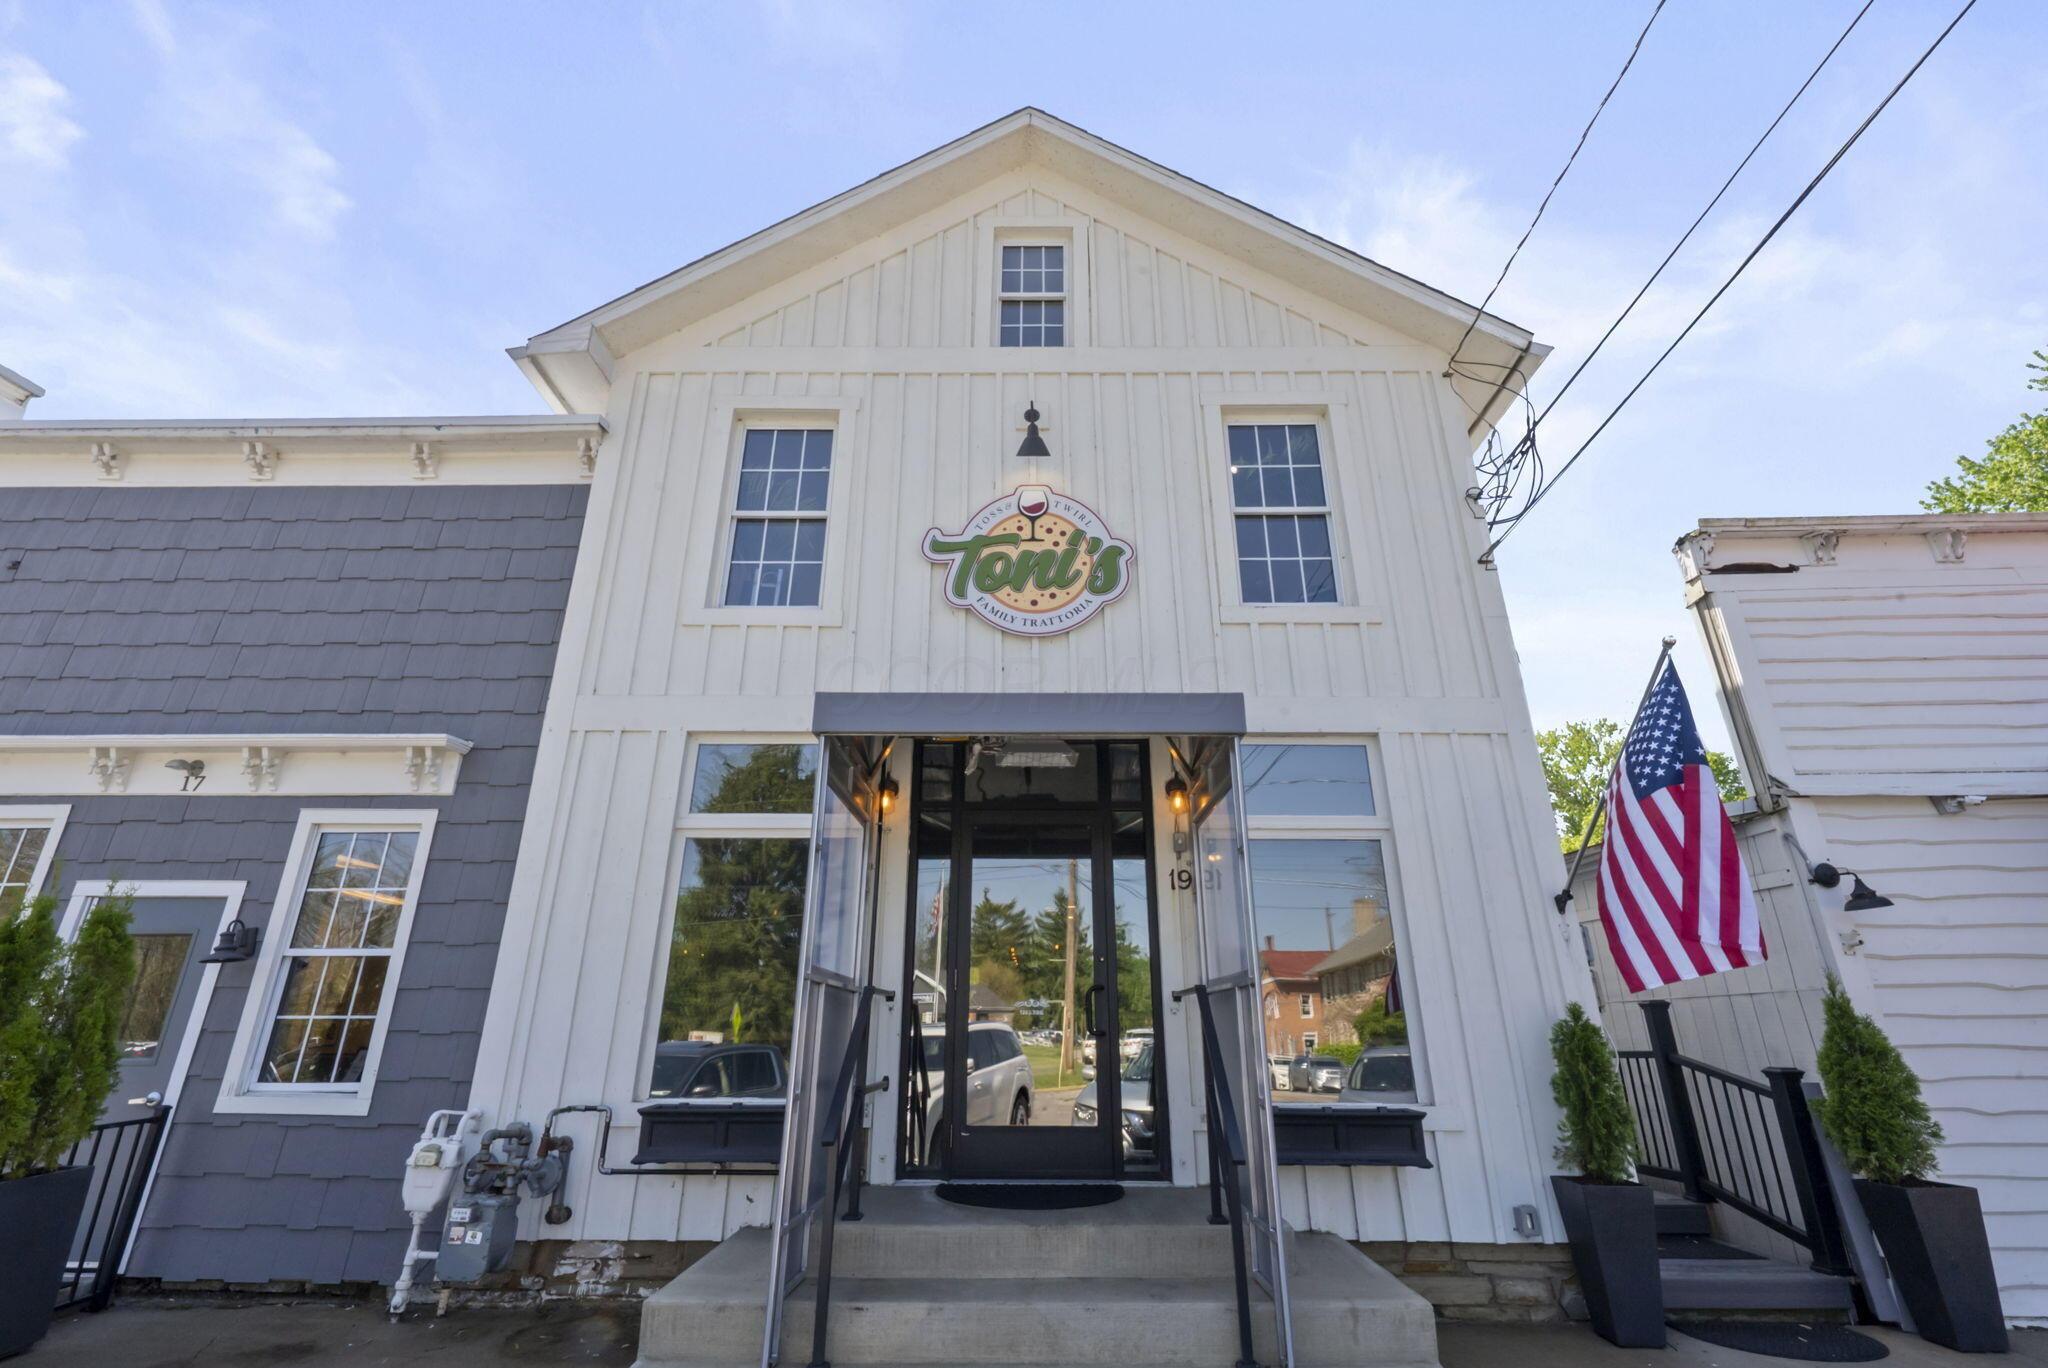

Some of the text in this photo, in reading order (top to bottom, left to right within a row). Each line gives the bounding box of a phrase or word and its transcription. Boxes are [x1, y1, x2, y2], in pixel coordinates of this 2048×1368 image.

[974, 505, 1003, 531] TOSS
[1053, 500, 1092, 529] TWIRL
[929, 529, 1126, 600] Toni's
[976, 596, 1094, 628] FAMILY TRATTORIA
[180, 776, 206, 791] 17
